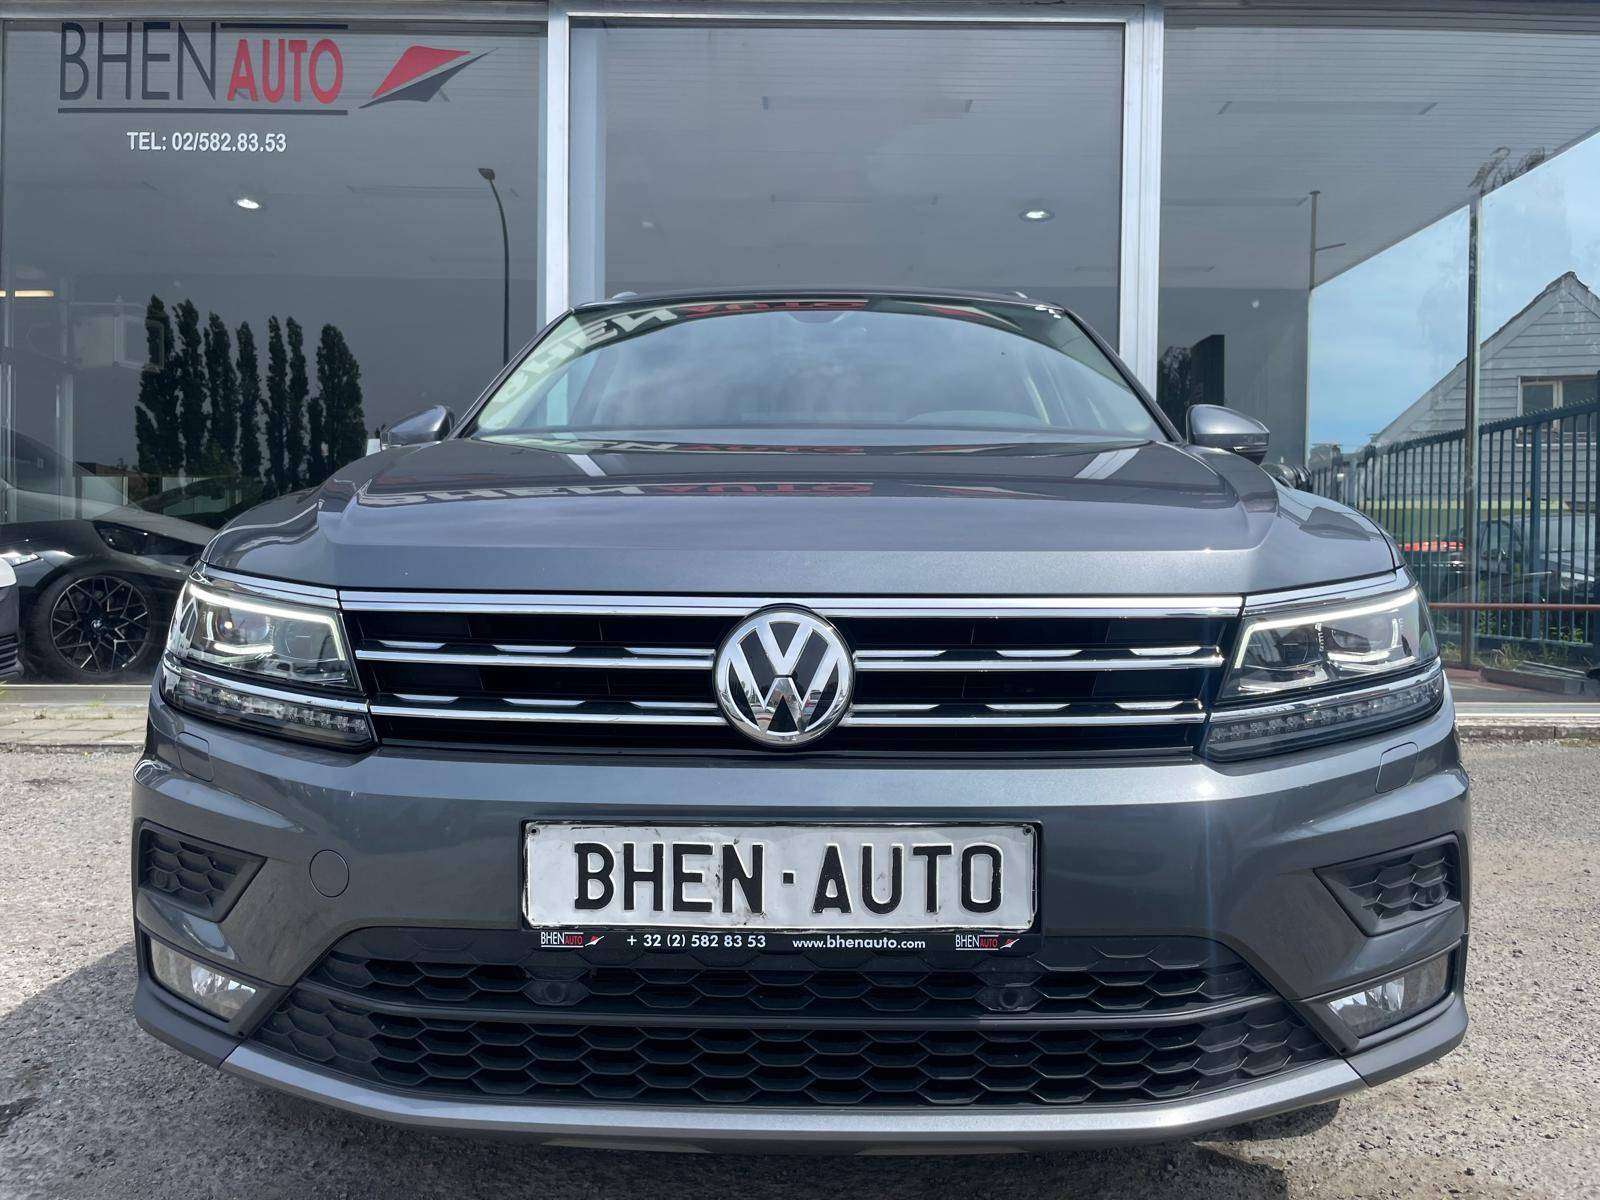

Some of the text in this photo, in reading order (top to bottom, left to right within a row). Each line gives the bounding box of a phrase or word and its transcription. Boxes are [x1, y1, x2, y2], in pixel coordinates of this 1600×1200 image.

[59, 21, 344, 104] BHEN AUTO
[126, 131, 287, 153] TEL: 02/582.83.53
[574, 842, 764, 913] BHEN
[812, 844, 1002, 914] AUTO
[540, 932, 583, 945] BHEN AUTO
[643, 934, 662, 947] 32
[666, 934, 686, 948] (2)
[691, 934, 719, 947] 582
[724, 935, 743, 948] 83
[747, 935, 766, 948] 53
[792, 935, 926, 949] www.bhenauto.com
[955, 934, 998, 948] BHEN AUTO
